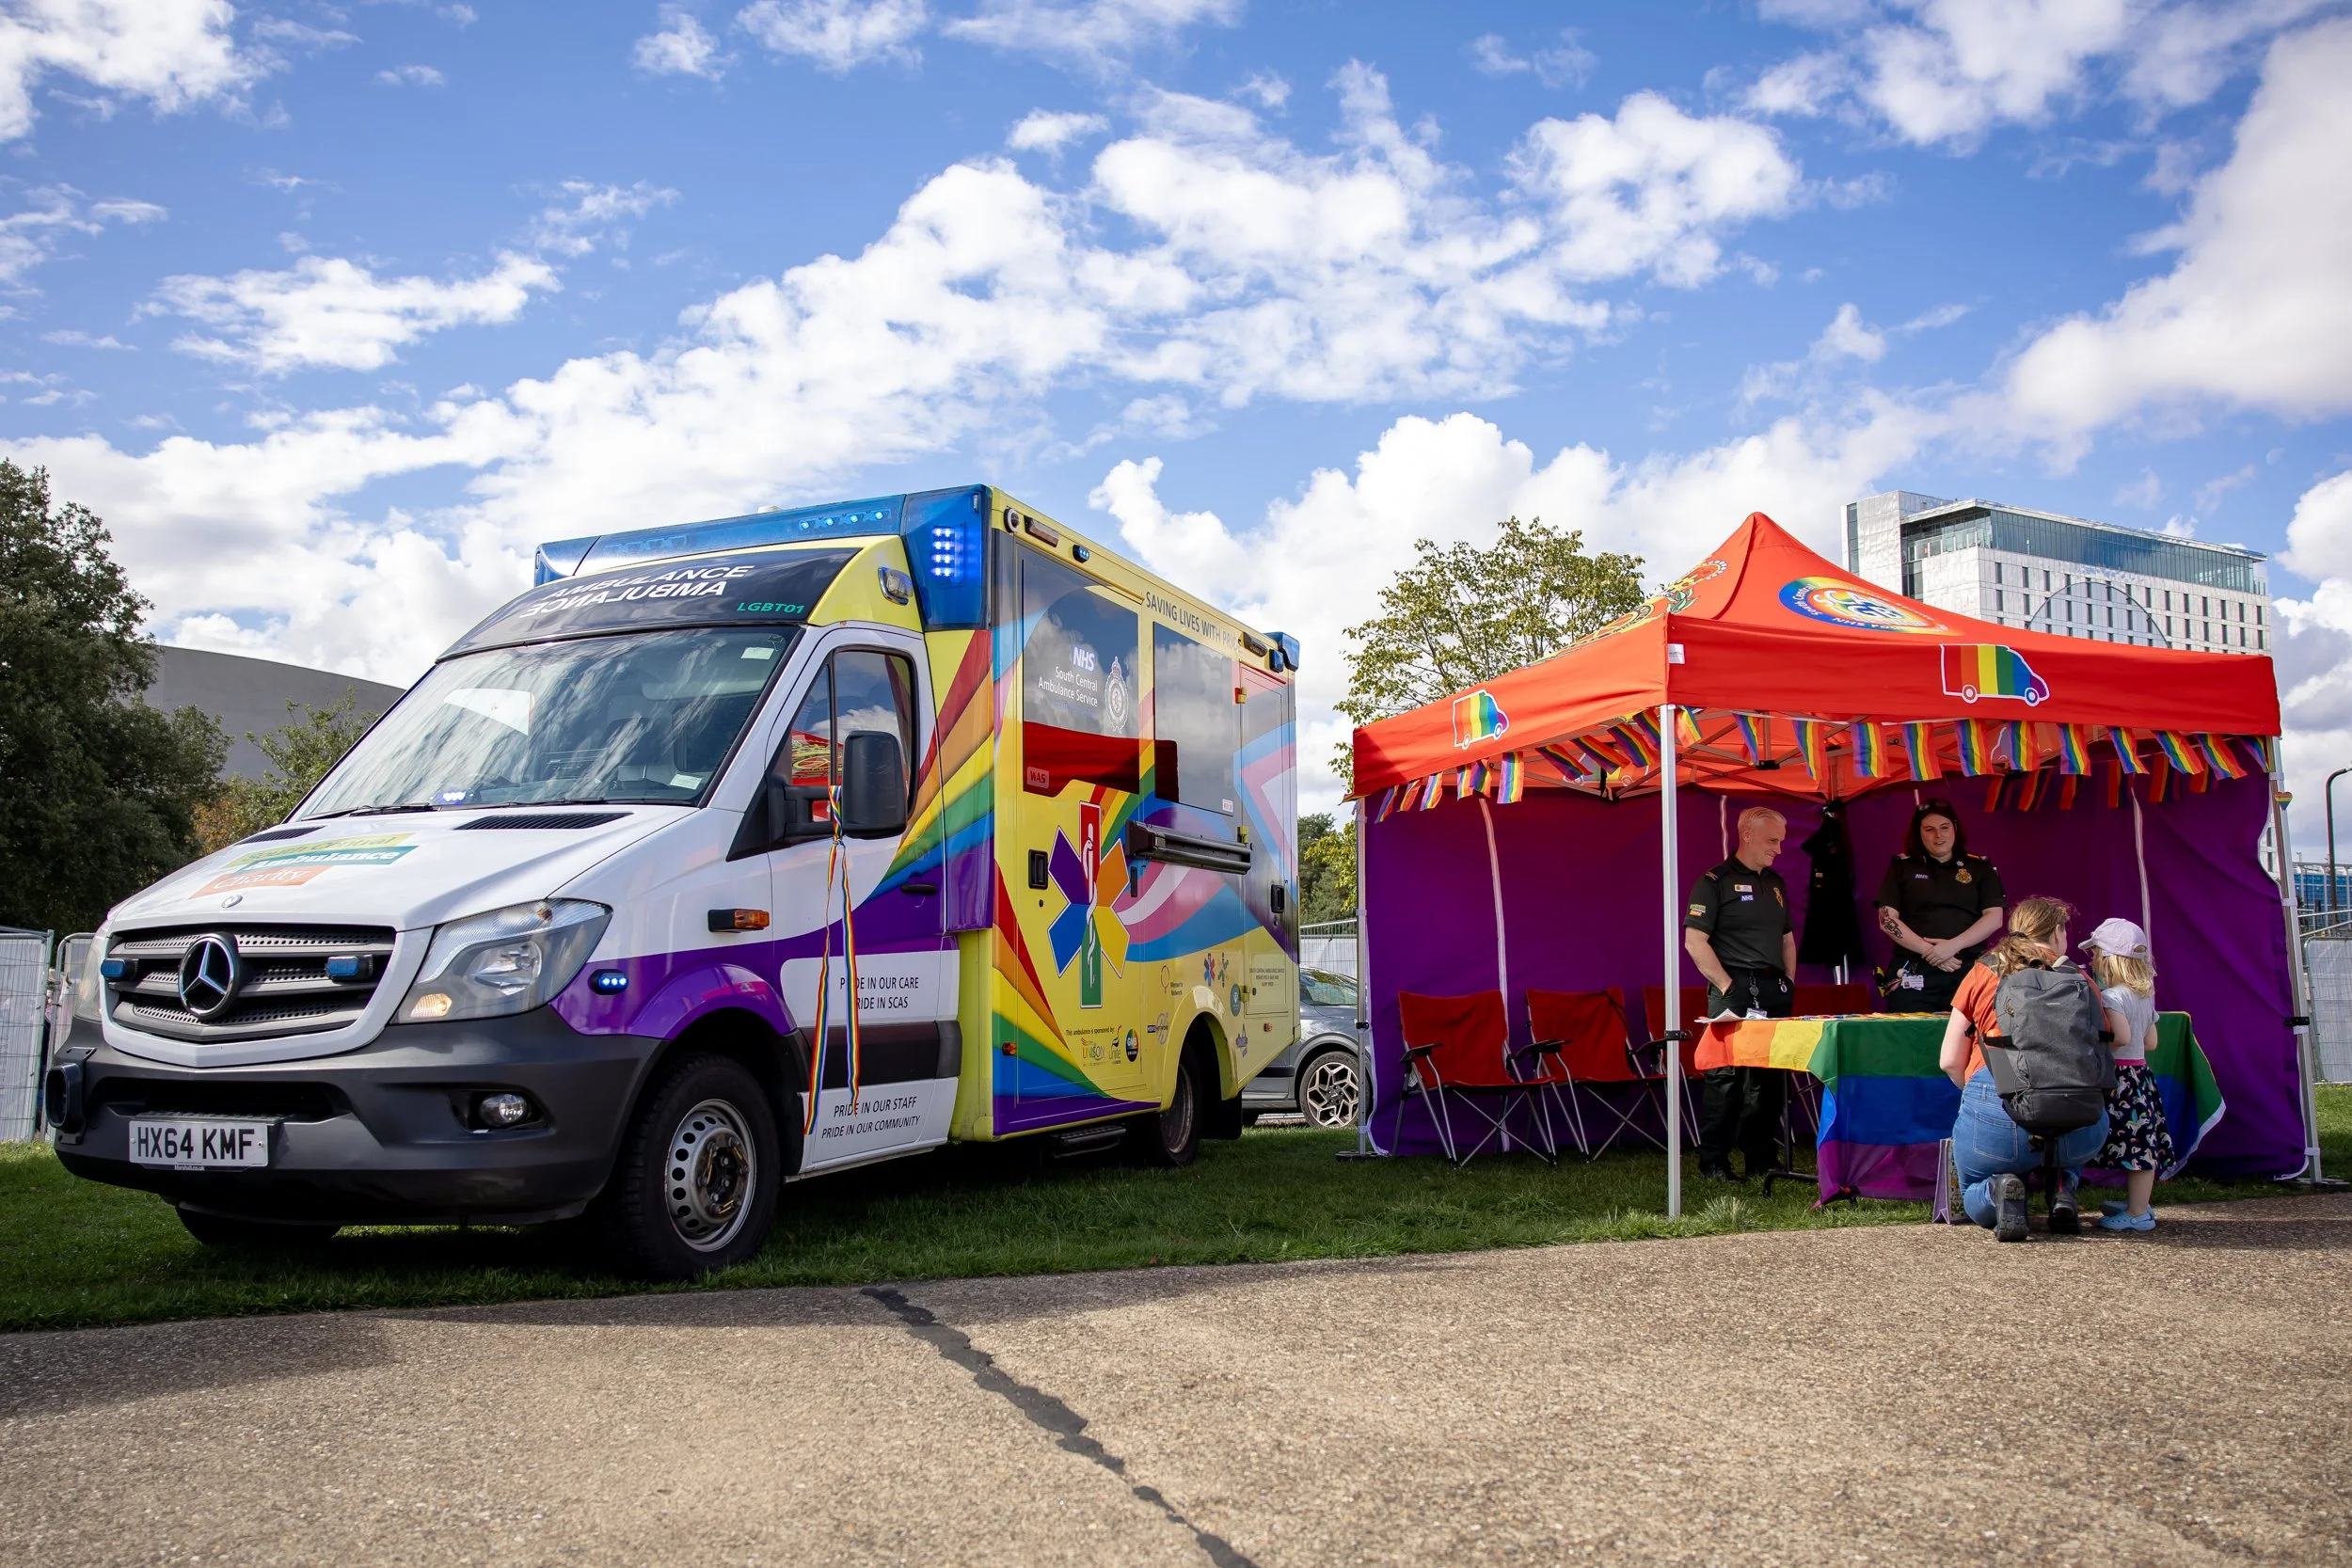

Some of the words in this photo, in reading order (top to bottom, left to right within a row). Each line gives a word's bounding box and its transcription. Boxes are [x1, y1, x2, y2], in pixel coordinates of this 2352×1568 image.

[542, 565, 755, 601] AMBULANCE
[737, 601, 805, 614] LGBT01
[1146, 591, 1178, 622] SAVING
[1179, 608, 1200, 633] LIVES
[1201, 620, 1221, 644] WITH
[1073, 646, 1095, 672] NHS
[1055, 666, 1074, 684] South
[1075, 673, 1098, 692] Central
[1038, 676, 1075, 700] Ambulance
[1076, 689, 1098, 707] Service
[1029, 770, 1046, 784] WAS
[311, 836, 398, 851] Central
[246, 849, 402, 871] Ambulance
[213, 867, 314, 890] Charity
[840, 976, 865, 990] PDE
[867, 976, 877, 990] IN
[879, 976, 897, 990] OUR
[898, 976, 919, 990] CARE
[877, 997, 886, 1009] IN
[888, 996, 909, 1009] SCAS
[861, 1102, 871, 1115] IN
[873, 1099, 892, 1113] OUR
[893, 1096, 917, 1110] STAFF
[821, 1126, 845, 1139] PRIDE
[846, 1124, 855, 1136] IN
[856, 1121, 873, 1134] OUR
[875, 1116, 921, 1132] COMMUNITY
[137, 1127, 195, 1160] HX64
[202, 1128, 256, 1161] KMF
